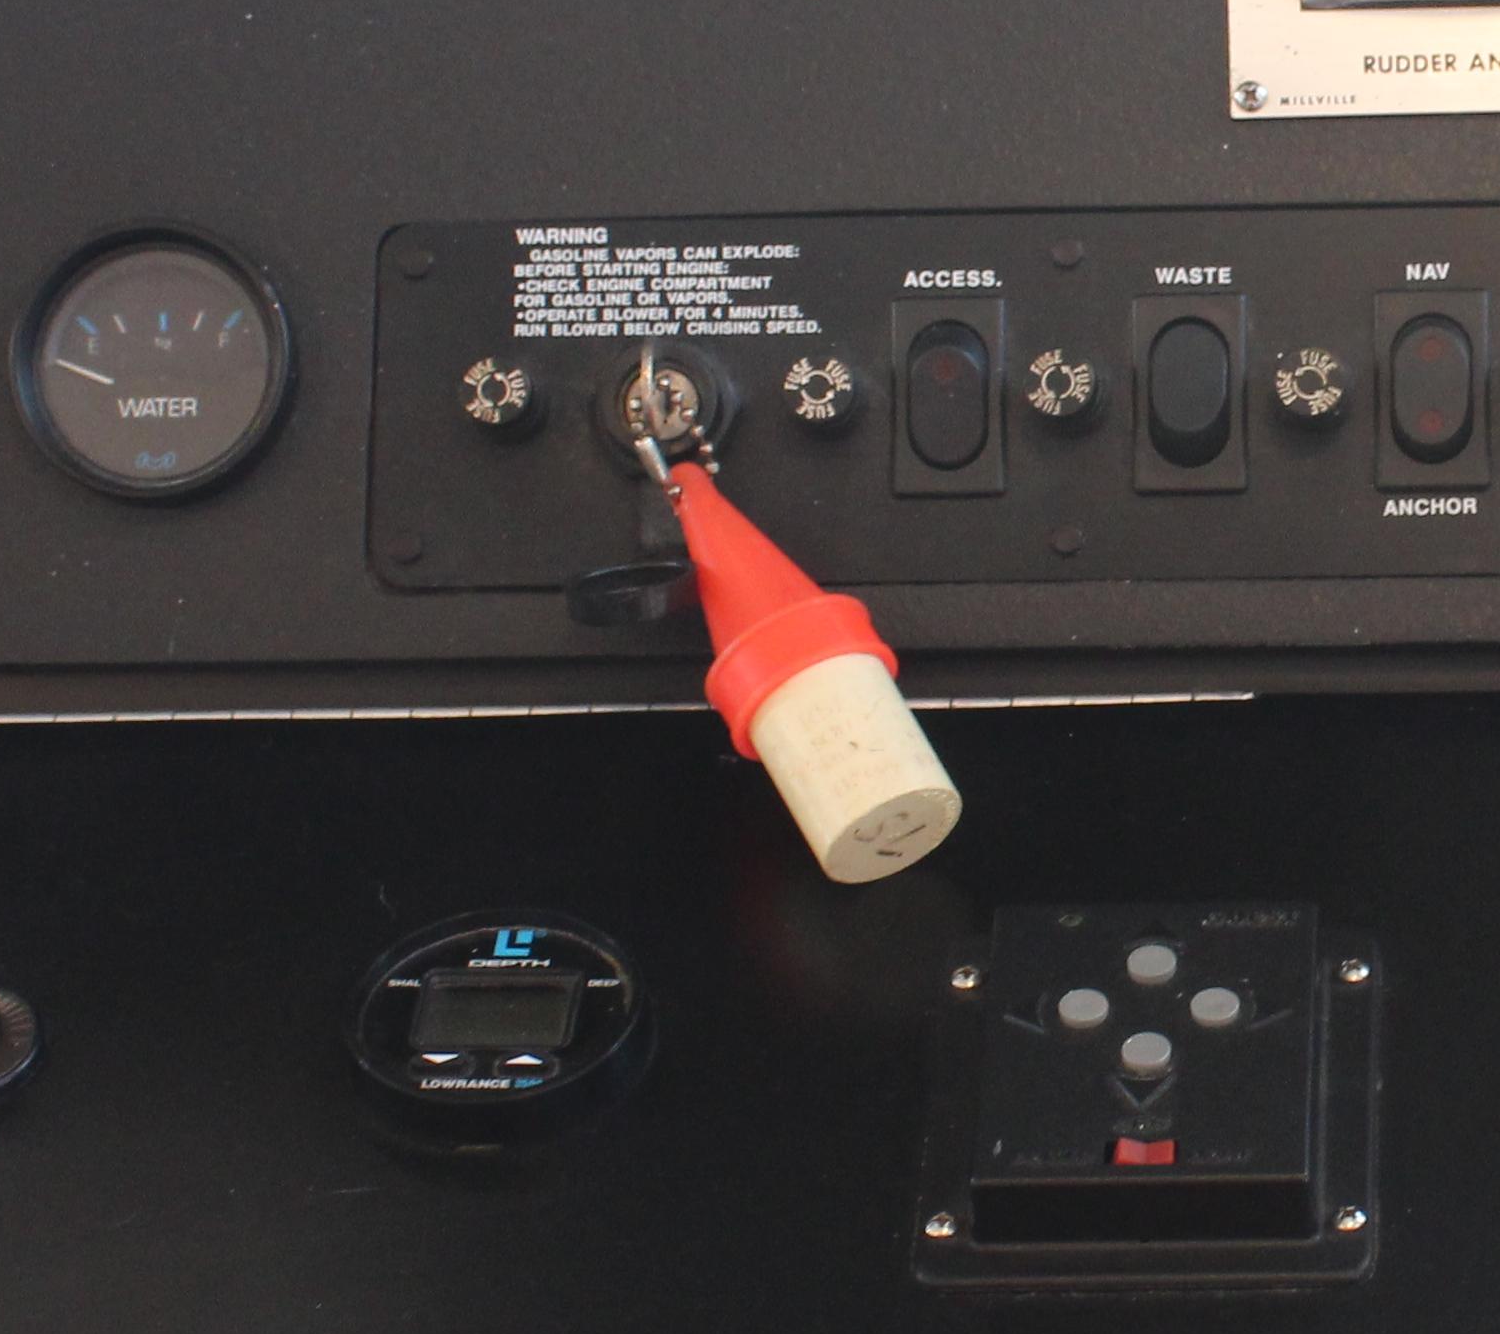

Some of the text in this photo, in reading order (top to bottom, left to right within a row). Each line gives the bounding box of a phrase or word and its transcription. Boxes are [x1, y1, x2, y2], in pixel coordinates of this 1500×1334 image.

[1363, 54, 1457, 75] RUDDER
[1280, 95, 1357, 107] MILLVILLE
[516, 228, 608, 245] WARNING
[530, 245, 800, 262] GASOLINE VAPORS CAN EXPLODE:
[514, 262, 730, 278] BEFORE STARTING ENGINE:
[1155, 267, 1232, 285] WASTE
[1405, 262, 1450, 281] NAV
[587, 278, 645, 292] ENGINE
[651, 276, 772, 291] COMPARTMENT
[903, 270, 1002, 289] ACCESS.
[514, 291, 733, 307] FOR GASOLINE OR VAPORS.
[603, 307, 668, 321] BLOWER
[675, 306, 706, 320] FOR
[712, 306, 722, 319] 4
[729, 305, 803, 319] MINUTES.
[514, 319, 822, 337] RUN BLOWER BELOW CRUISING SPEED.
[1300, 349, 1339, 374] FUSE
[825, 358, 853, 392] FUSE
[1071, 363, 1091, 403] FUSE
[507, 368, 527, 408] FUSE
[1276, 369, 1298, 406] FUSE
[117, 398, 199, 418] WATER
[795, 401, 837, 420] FUSE
[1383, 499, 1477, 518] ANCHOR
[467, 958, 552, 968] DEPTH
[587, 979, 621, 988] DEEP
[420, 1078, 511, 1090] LOWRANCE
